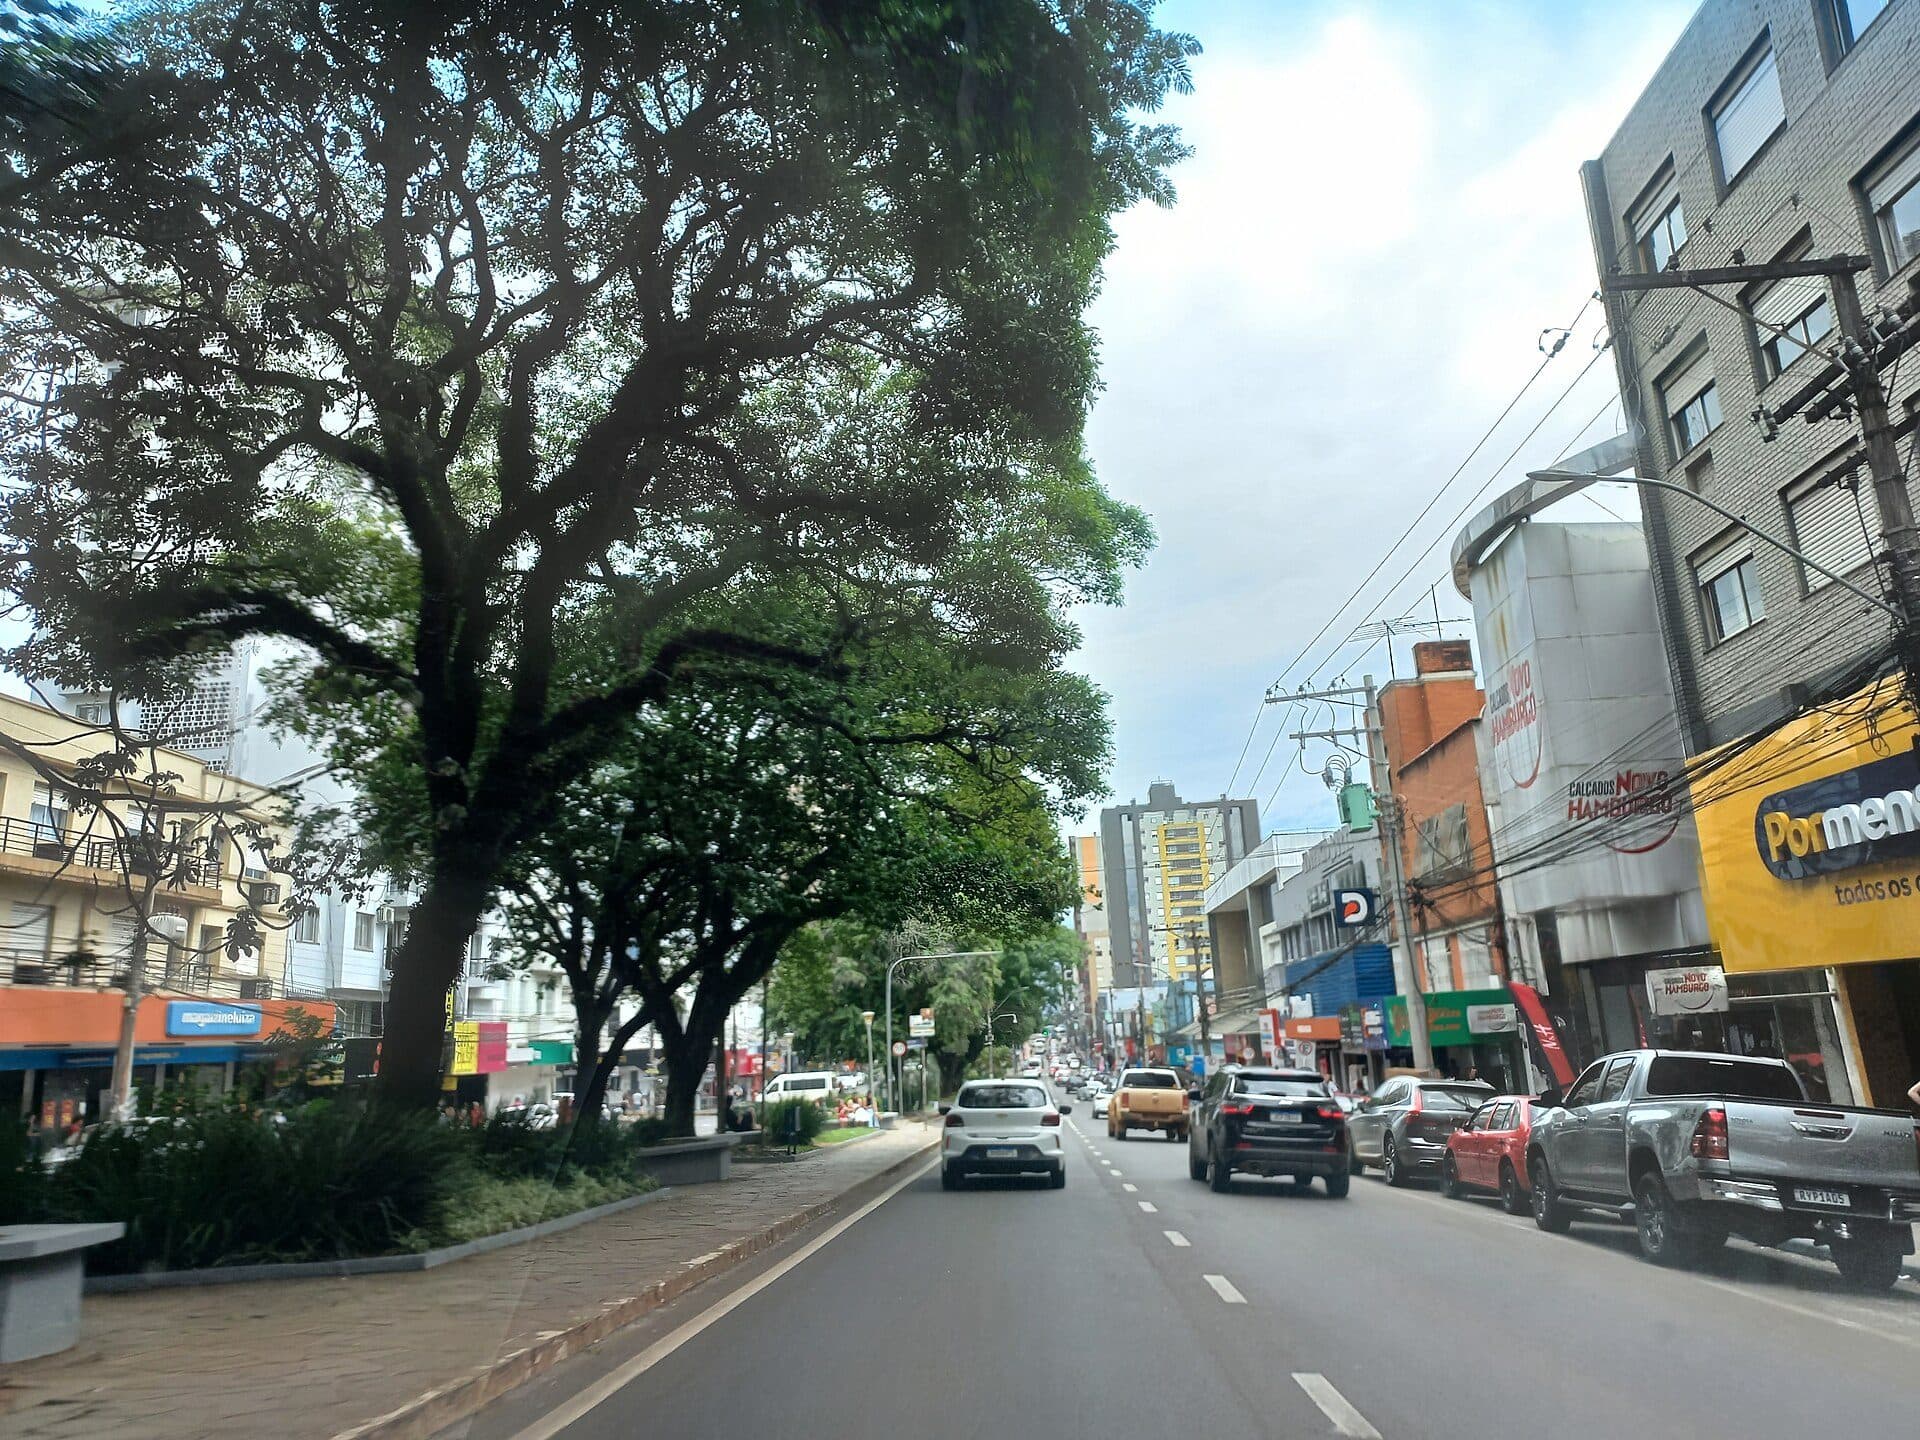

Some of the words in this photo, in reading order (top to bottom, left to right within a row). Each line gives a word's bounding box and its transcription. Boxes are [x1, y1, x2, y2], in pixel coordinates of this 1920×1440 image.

[1763, 785, 1920, 863] Pormen
[1834, 880, 1886, 906] todos
[1888, 876, 1912, 898] os
